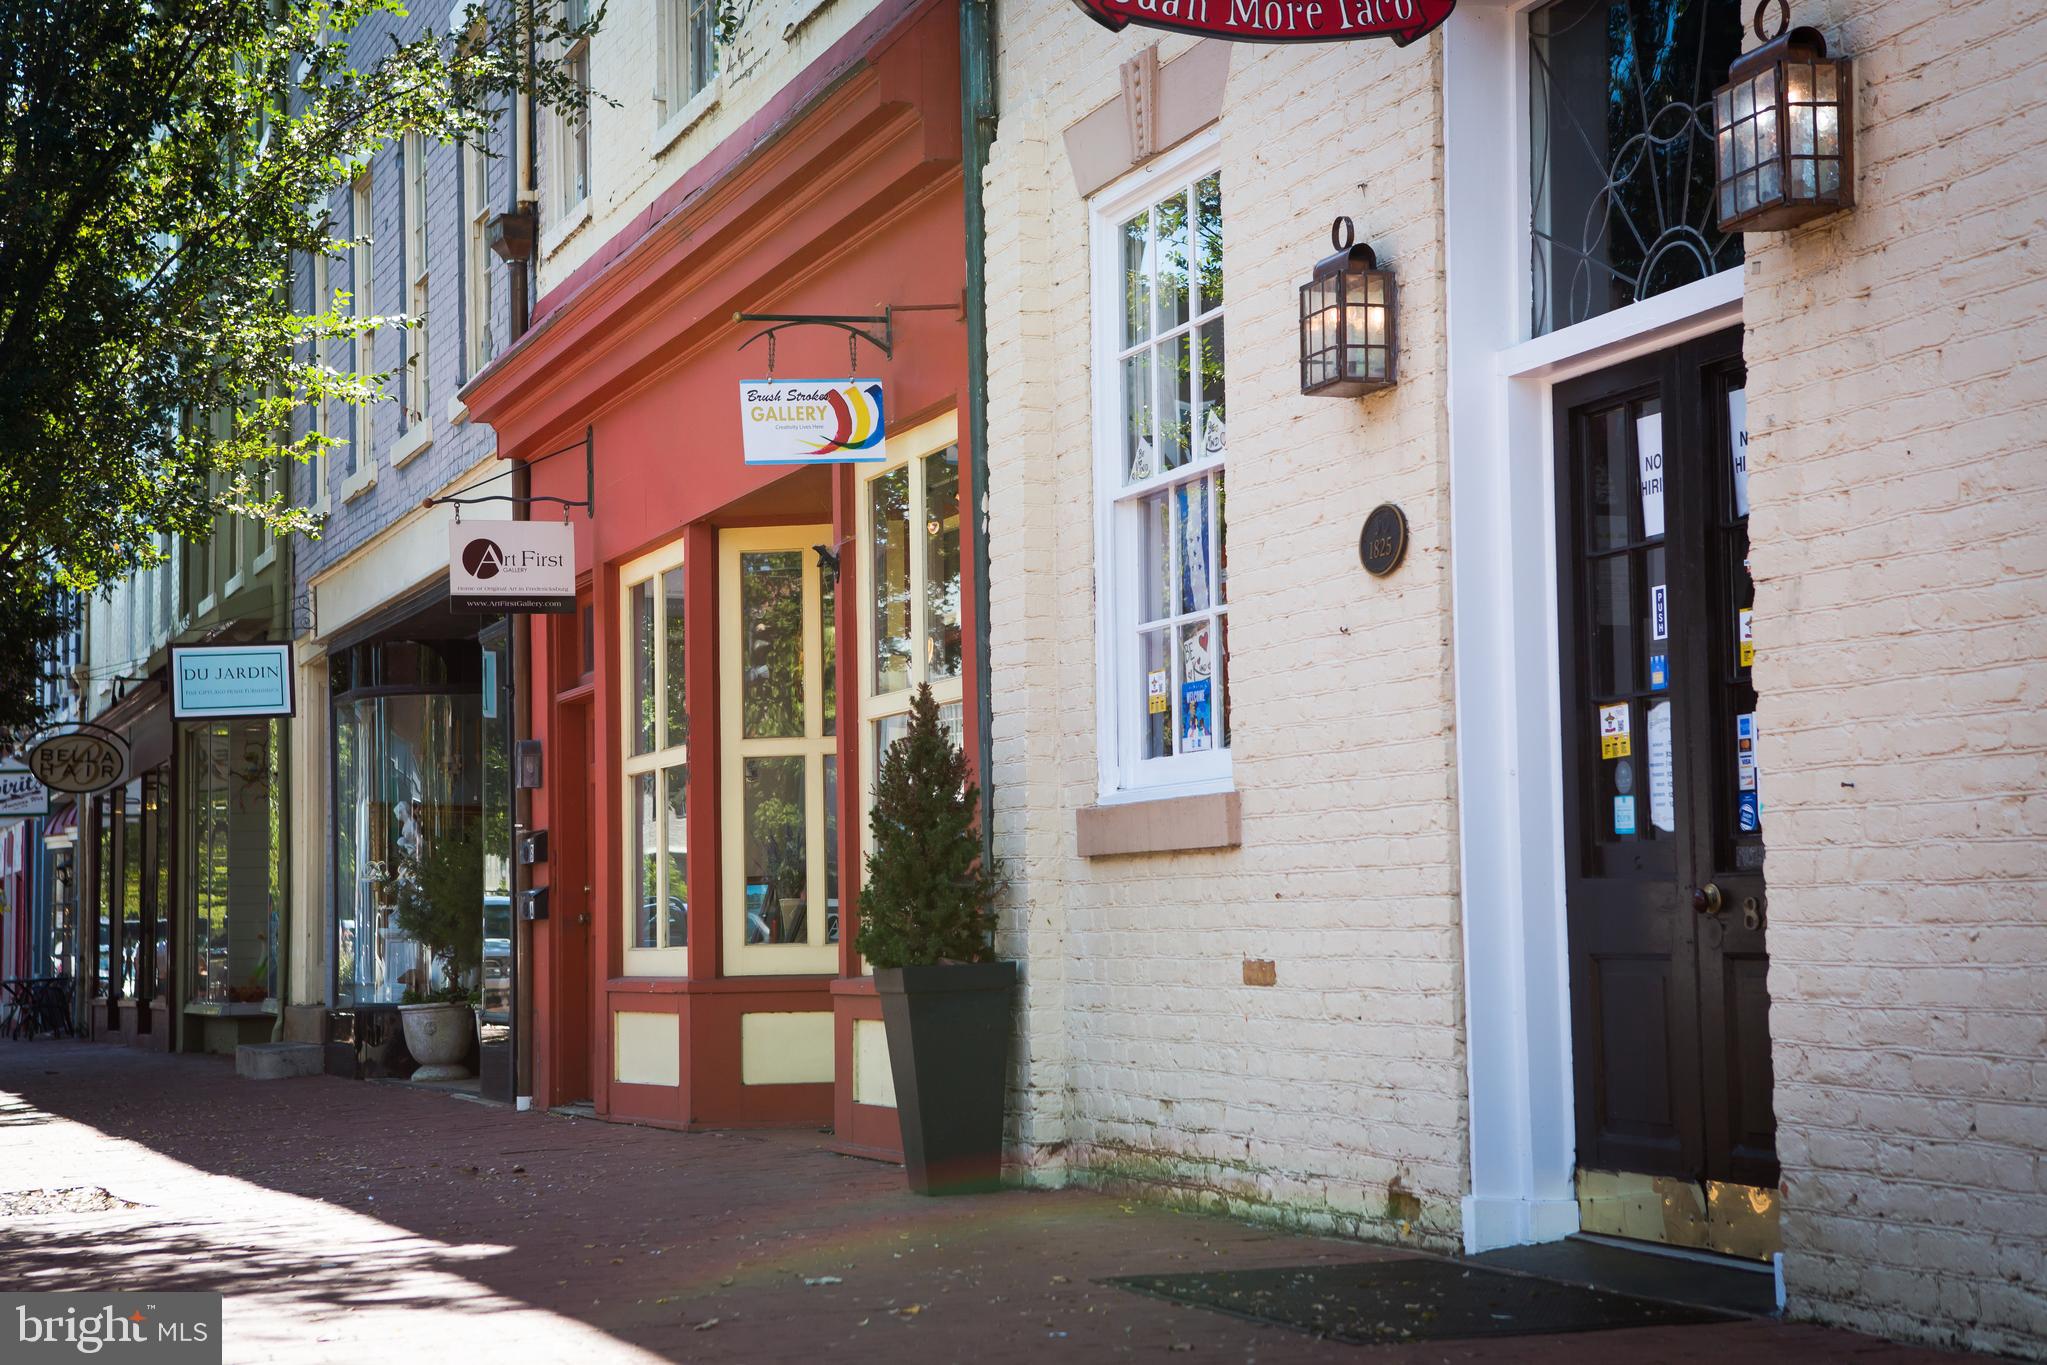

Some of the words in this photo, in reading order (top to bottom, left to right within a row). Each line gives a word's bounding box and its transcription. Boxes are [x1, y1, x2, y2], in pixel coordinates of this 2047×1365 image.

[1114, 0, 1208, 23] uan
[1226, 0, 1324, 31] More
[747, 389, 782, 402] Brush
[786, 388, 830, 402] Strokes
[751, 405, 827, 422] GALLERY
[1368, 536, 1392, 560] 1825
[473, 544, 517, 577] Art
[521, 549, 564, 567] First
[466, 600, 562, 608] www.ArtFirstGallery.com
[1657, 592, 1665, 633] PUSH
[184, 668, 209, 681] DU
[215, 666, 279, 680] JARDIN
[40, 747, 114, 764] BELLA
[40, 763, 114, 778] HAIR
[0, 776, 43, 796] irits
